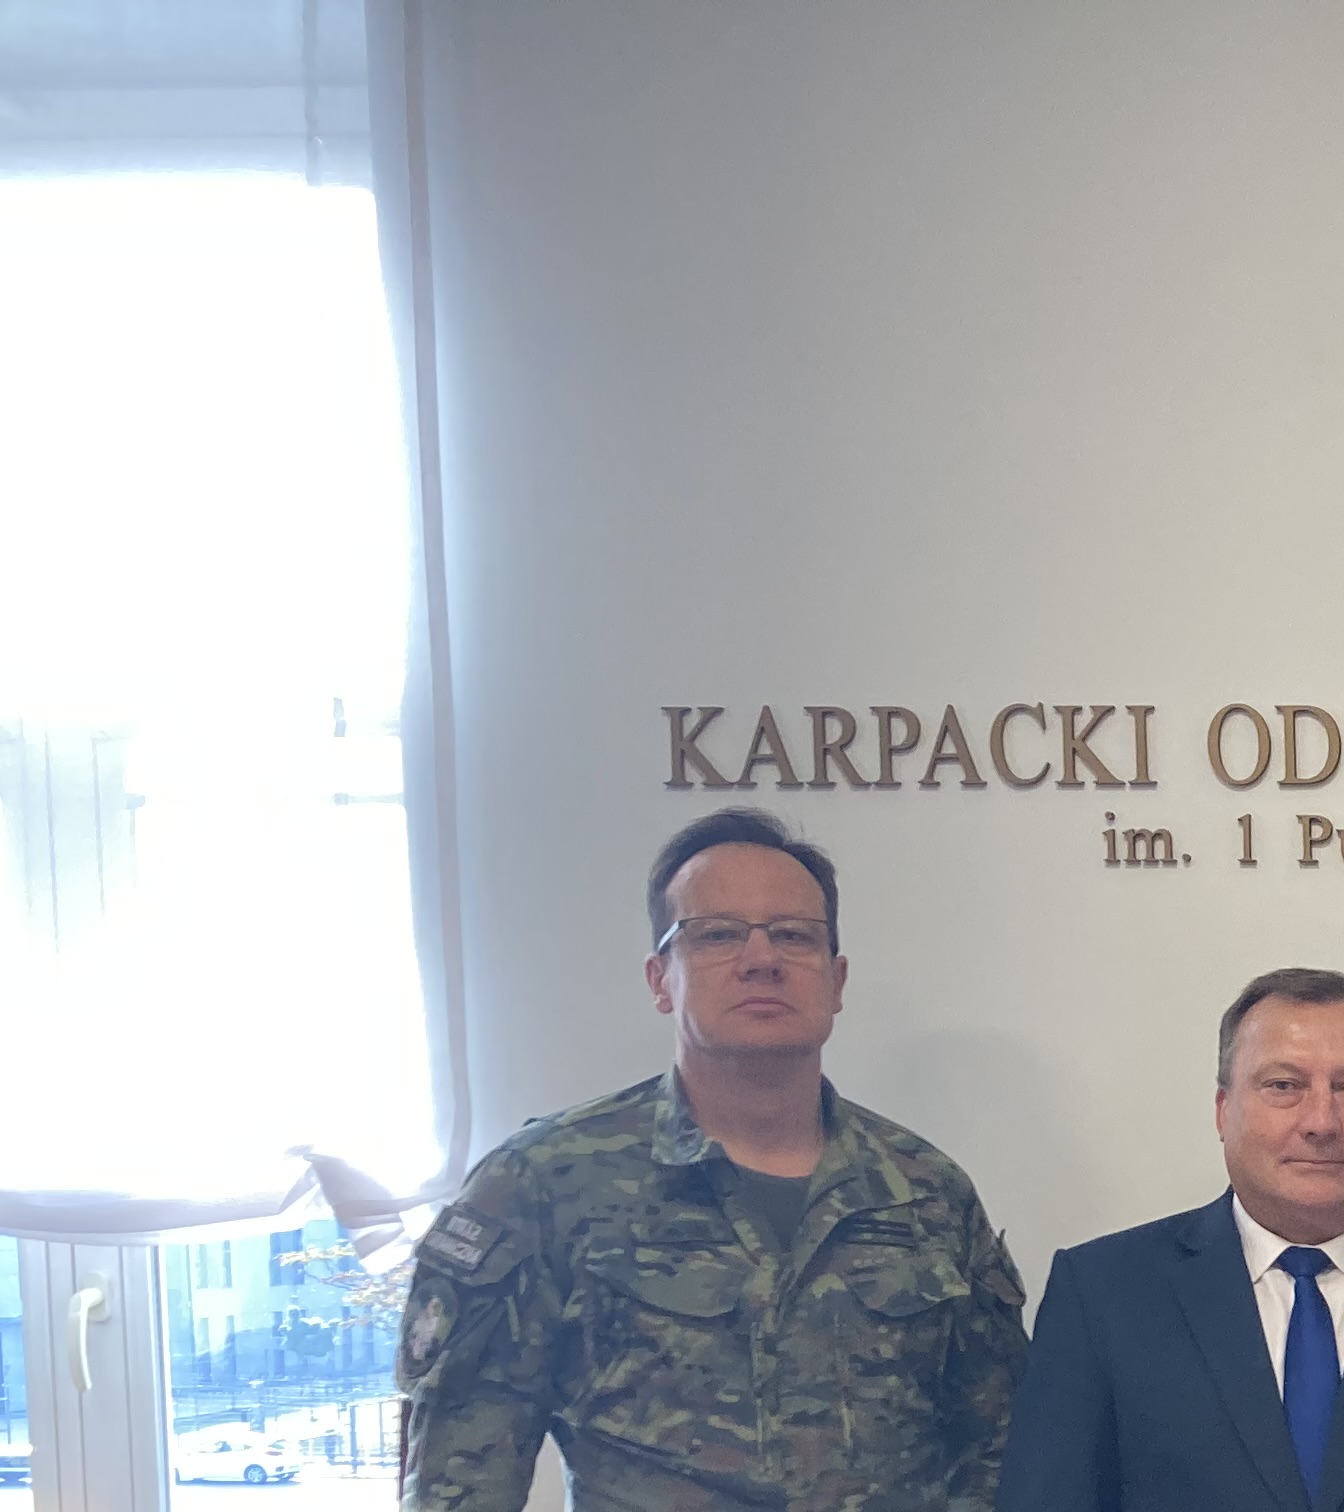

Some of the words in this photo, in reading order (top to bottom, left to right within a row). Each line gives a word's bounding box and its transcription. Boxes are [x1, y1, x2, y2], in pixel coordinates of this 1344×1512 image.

[660, 702, 1158, 790] KARPACKI
[1102, 811, 1192, 868] im.
[1237, 813, 1257, 868] 1
